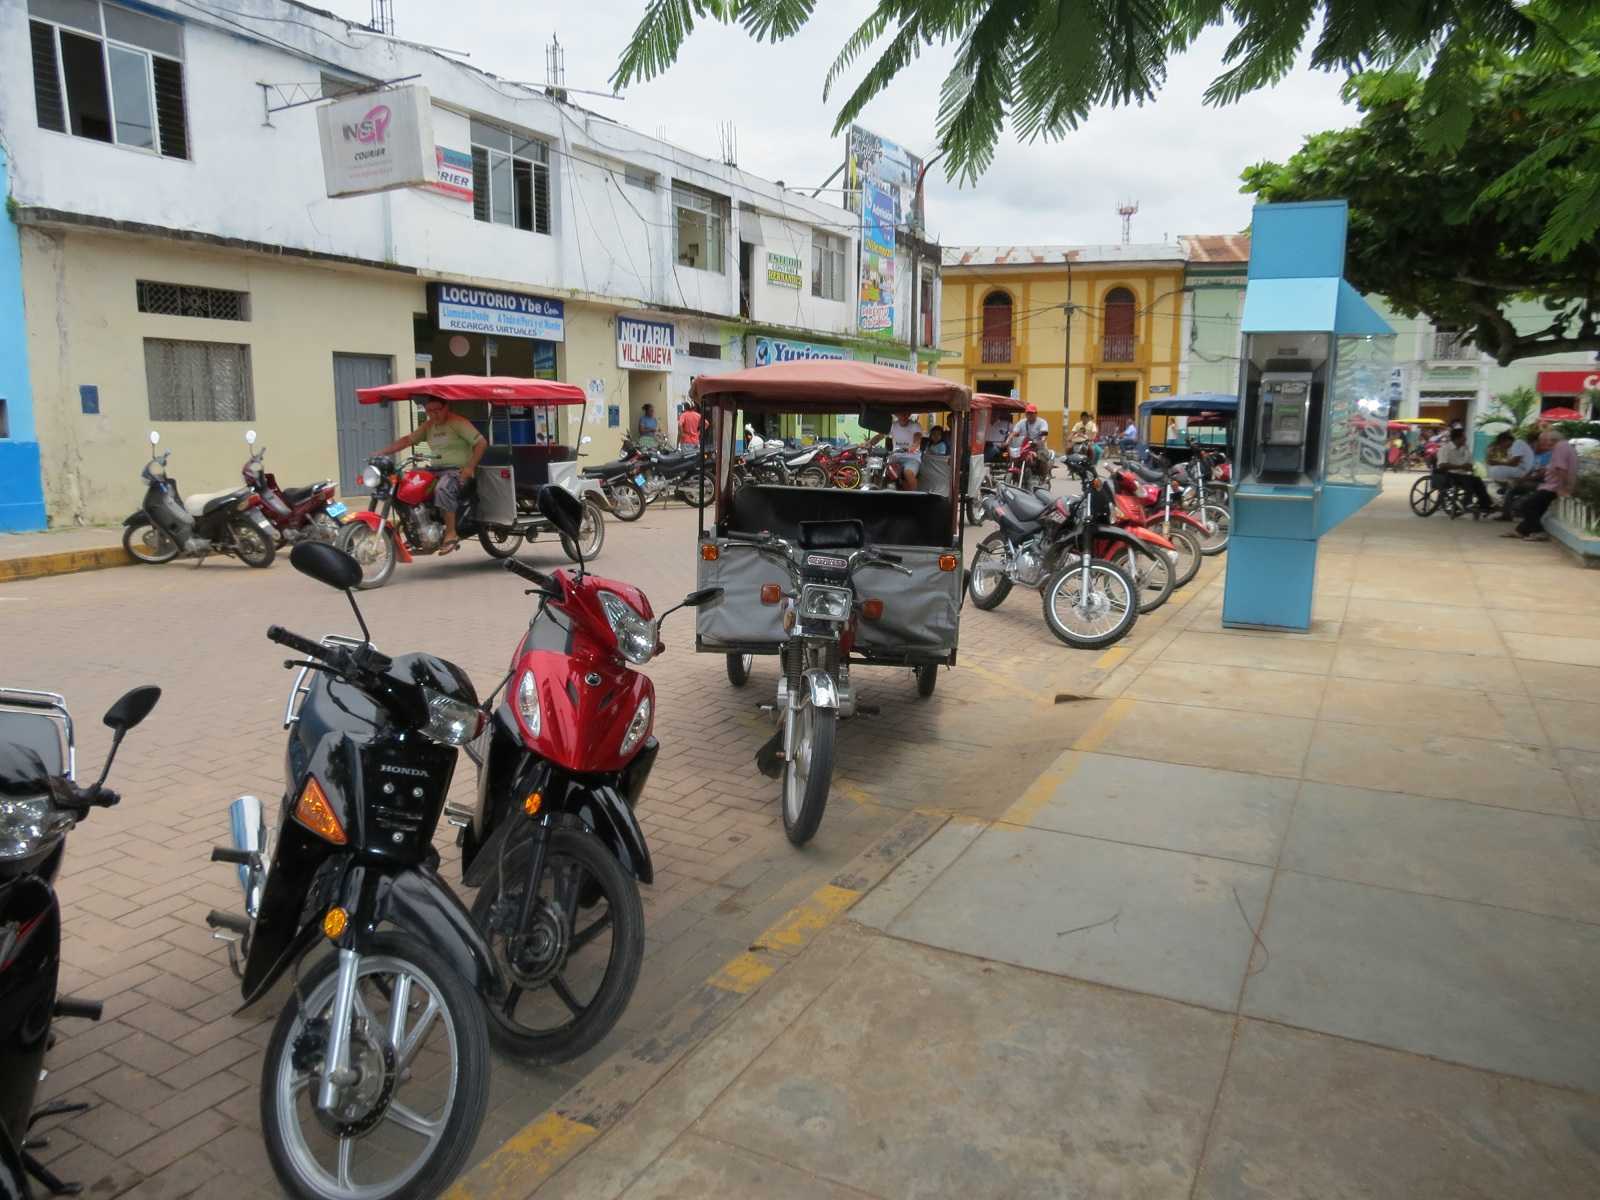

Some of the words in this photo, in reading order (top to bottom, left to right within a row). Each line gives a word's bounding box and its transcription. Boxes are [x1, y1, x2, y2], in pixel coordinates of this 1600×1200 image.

[437, 170, 469, 186] RIER
[442, 286, 516, 310] LOCUTORIO
[450, 320, 494, 332] RECARGAS
[496, 325, 537, 336] VIRTUALES
[621, 321, 670, 347] NOTARIA
[622, 344, 672, 366] VILLANUEVA
[380, 764, 430, 777] HONDA
